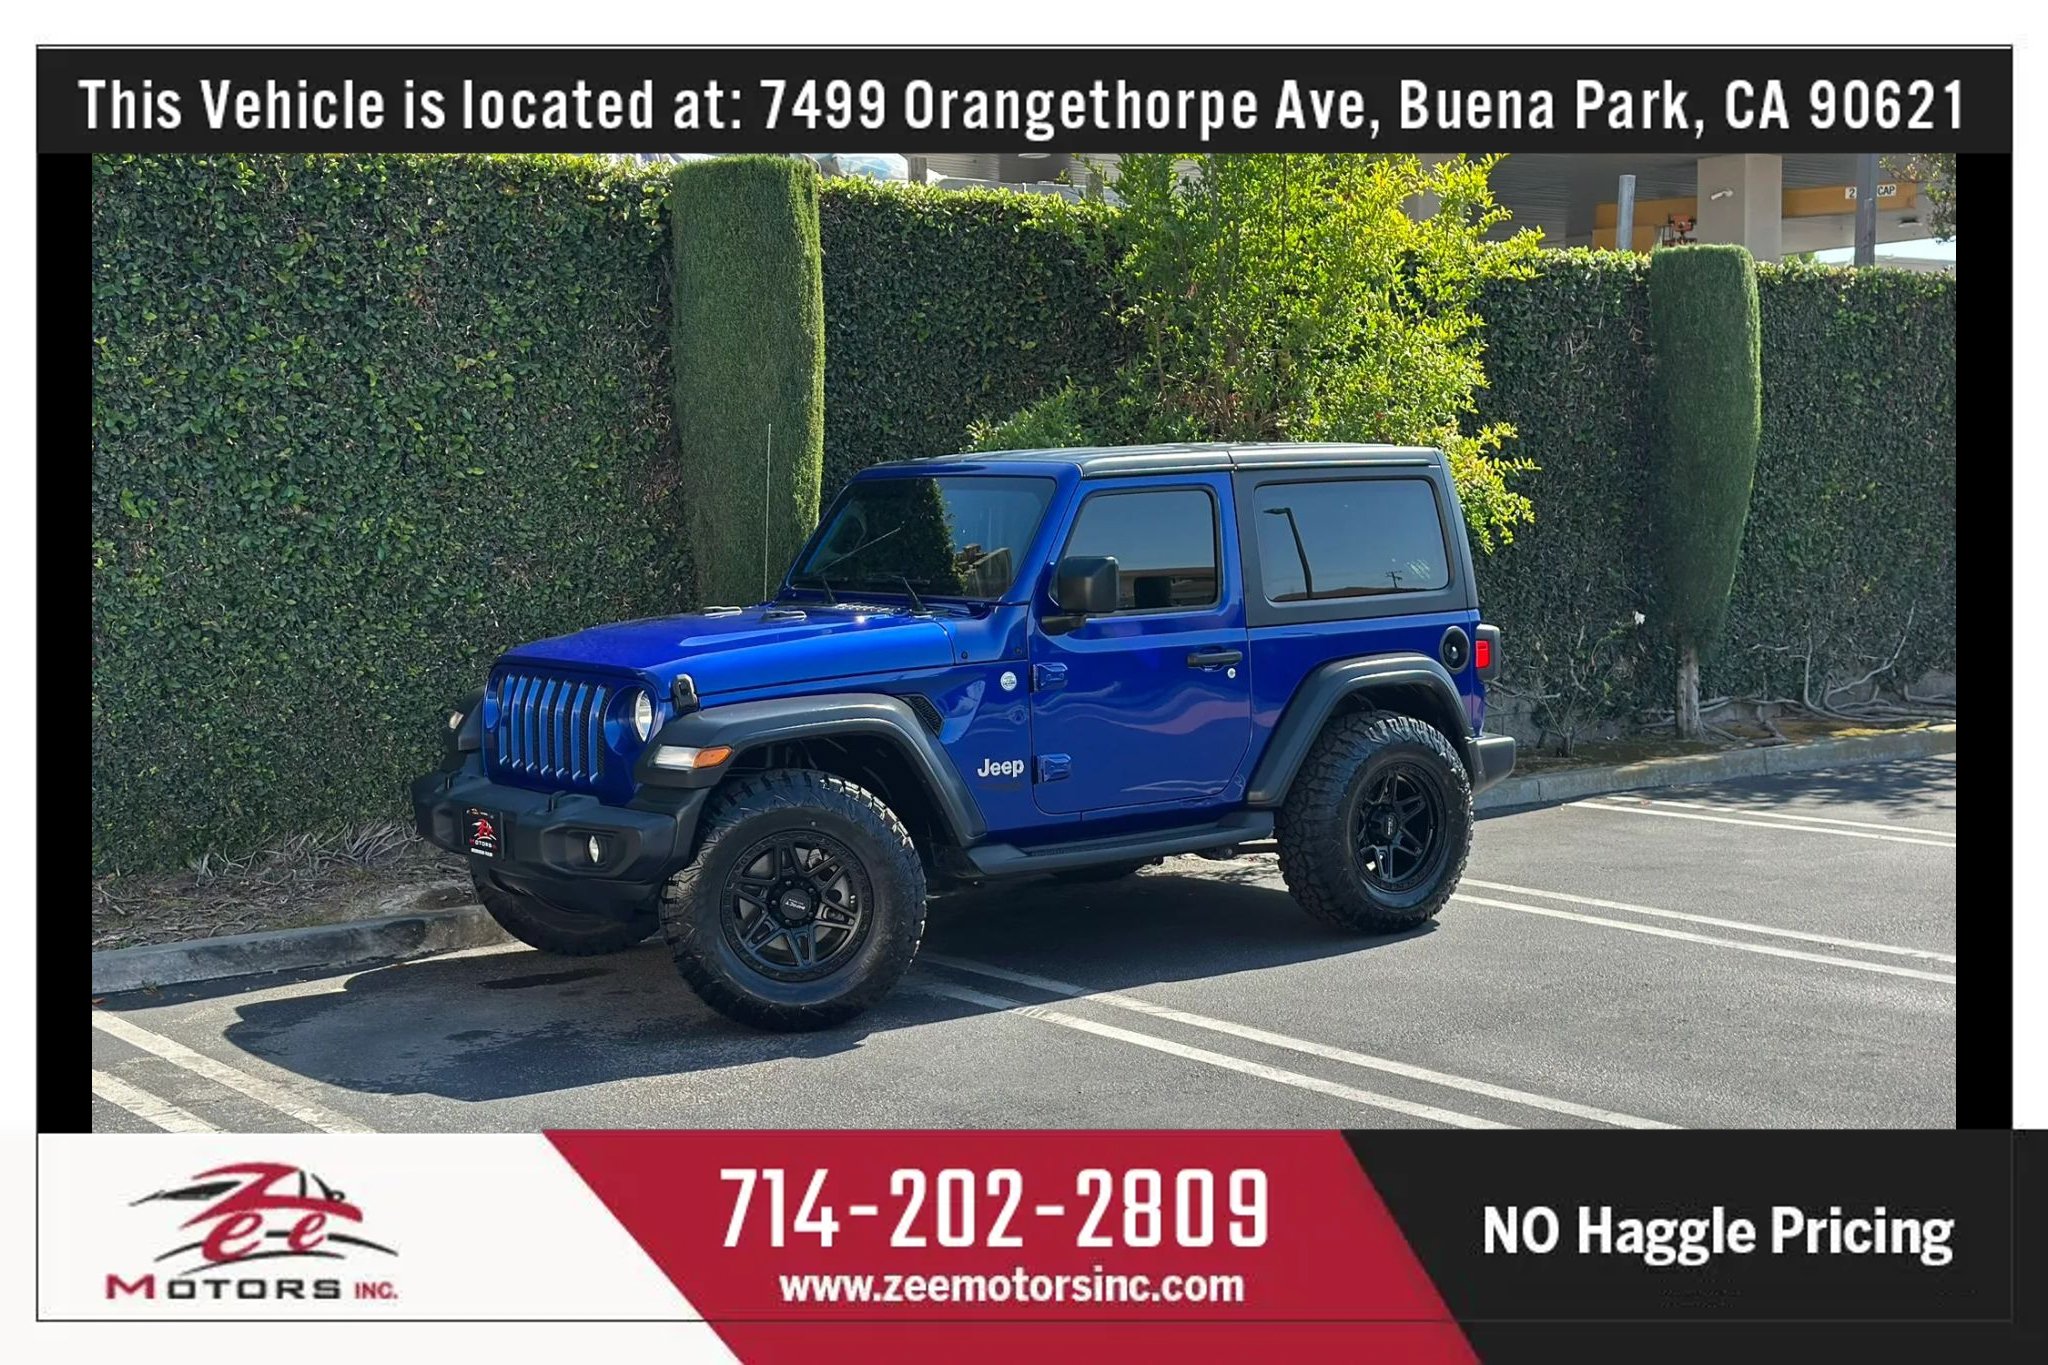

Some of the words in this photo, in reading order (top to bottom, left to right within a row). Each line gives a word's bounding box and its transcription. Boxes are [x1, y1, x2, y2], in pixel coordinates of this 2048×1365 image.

[1848, 188, 1856, 198] 2
[1877, 185, 1896, 197] CAP
[977, 758, 1025, 778] Jeep
